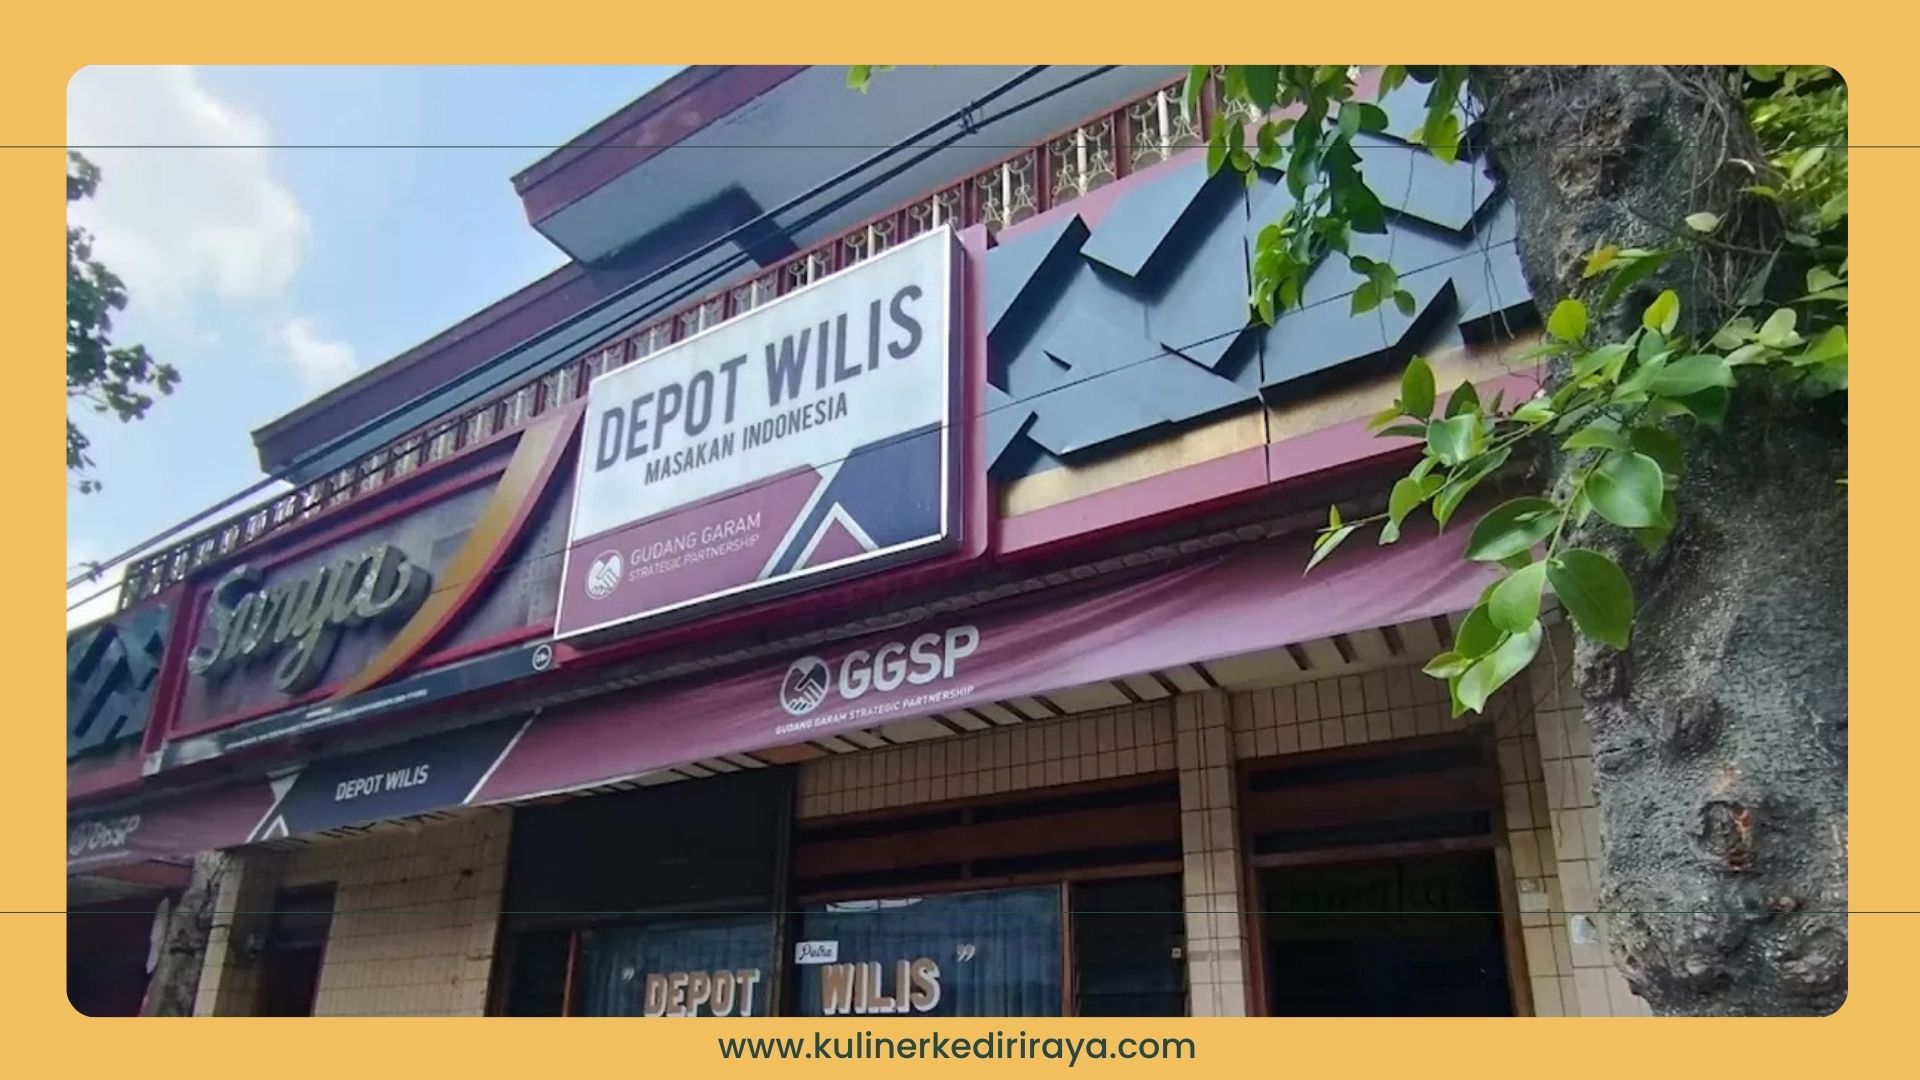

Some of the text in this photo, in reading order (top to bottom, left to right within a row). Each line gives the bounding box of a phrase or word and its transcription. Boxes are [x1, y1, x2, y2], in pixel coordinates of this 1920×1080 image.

[595, 285, 923, 472] DEPOT WILIS
[644, 393, 848, 486] MASAKAN INDONESIA
[628, 533, 760, 582] STRATEGIC PARTNERSHIP
[630, 511, 762, 566] GUDANG GARAM
[187, 544, 418, 692] Surya
[838, 624, 980, 699] GGSP
[775, 685, 975, 736] GUDANG GARAM STRATEGIC PARTNERSHIP
[334, 764, 430, 801] DEPOT WILIS
[644, 968, 761, 1017] DEPOT
[821, 957, 942, 1016] WILIS
